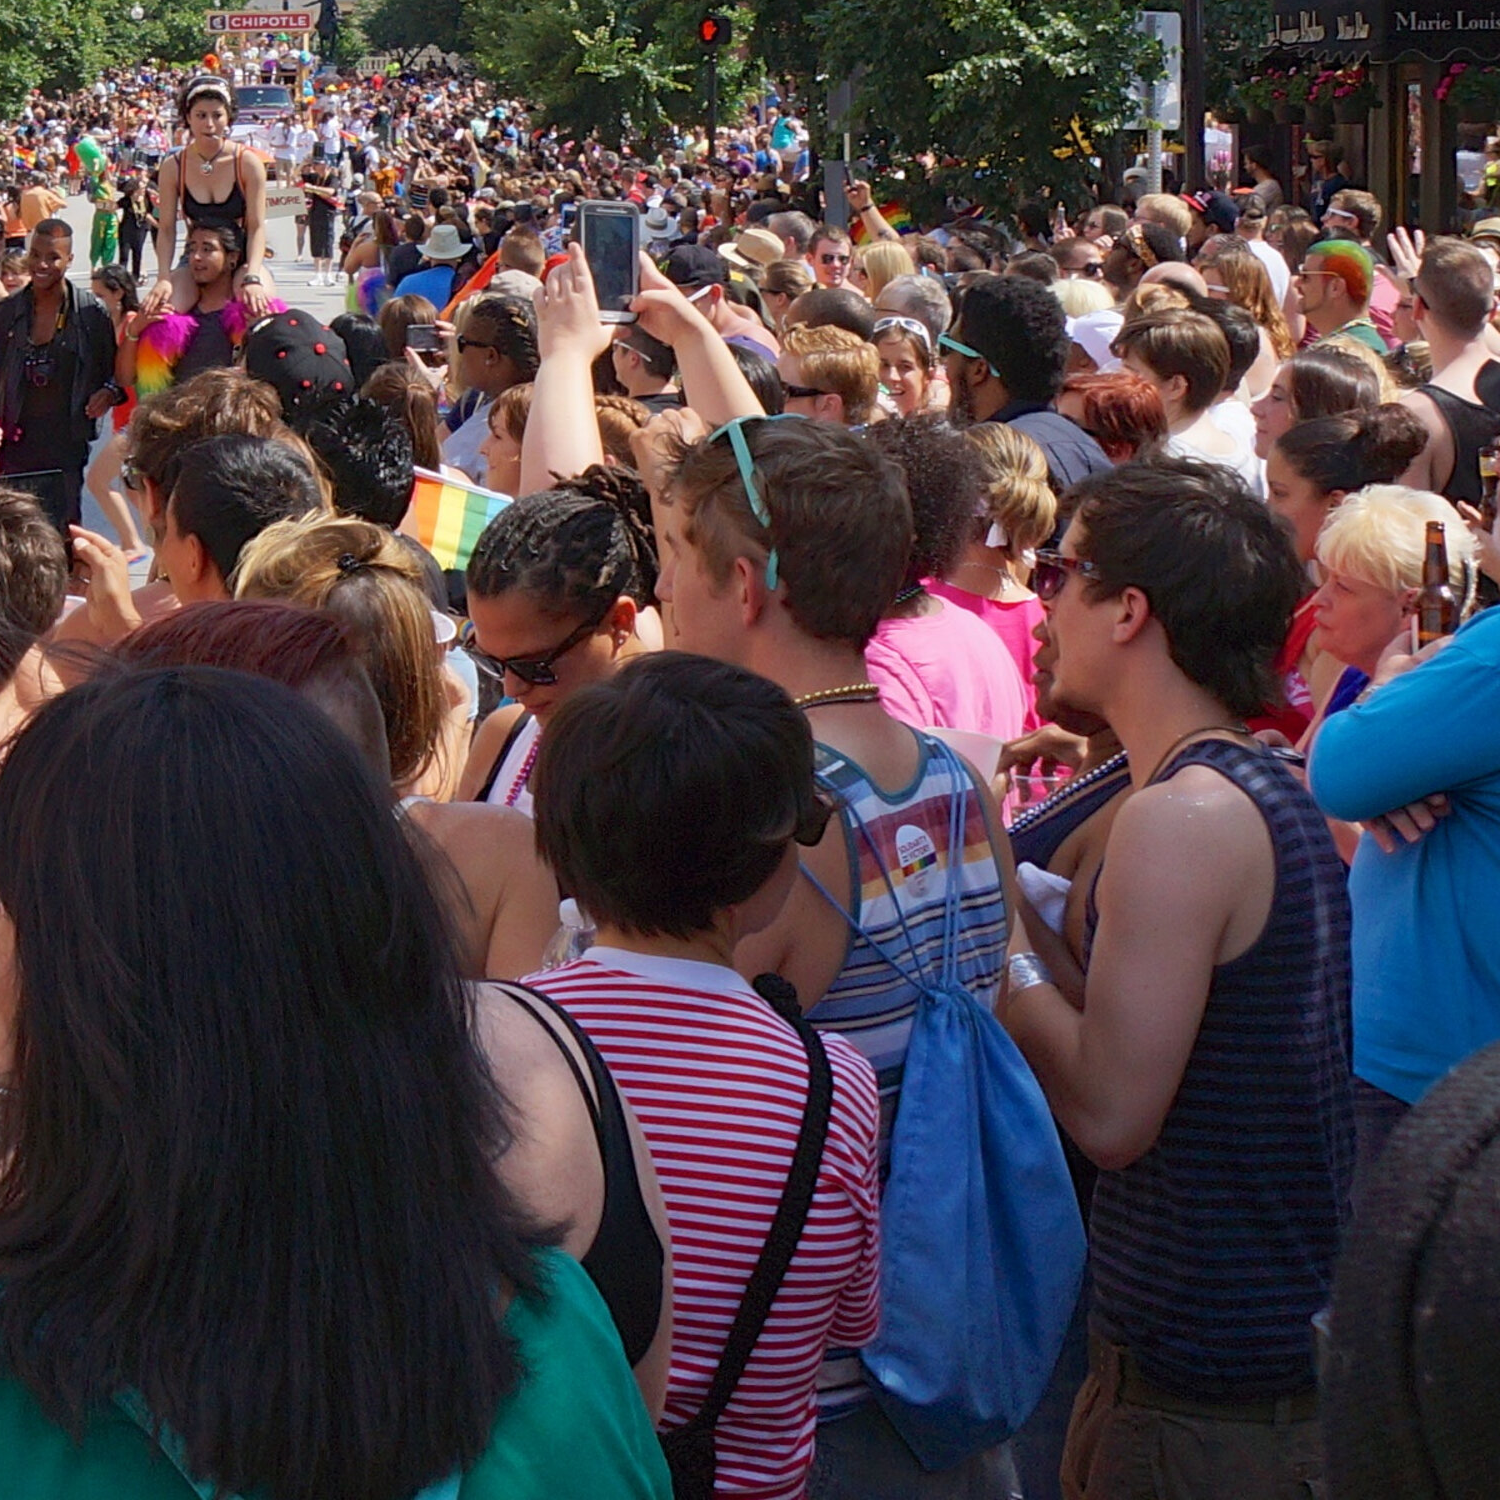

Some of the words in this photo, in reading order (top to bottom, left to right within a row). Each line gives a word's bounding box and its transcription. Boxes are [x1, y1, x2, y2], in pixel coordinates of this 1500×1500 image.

[230, 16, 308, 28] CHIPOTLE
[1394, 10, 1451, 31] Marie
[1456, 10, 1500, 31] Louis
